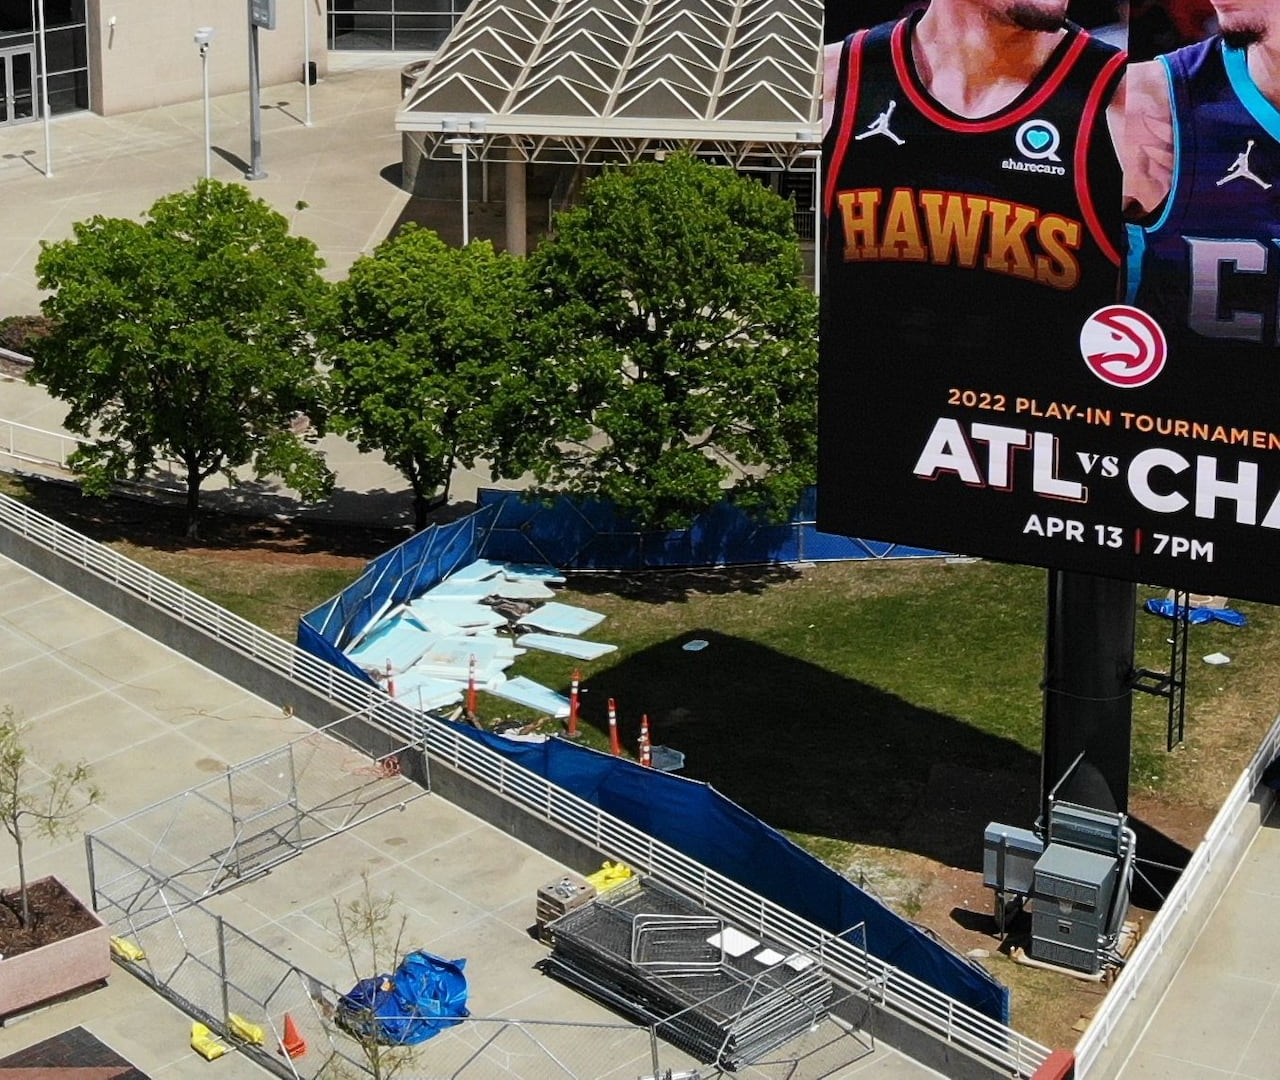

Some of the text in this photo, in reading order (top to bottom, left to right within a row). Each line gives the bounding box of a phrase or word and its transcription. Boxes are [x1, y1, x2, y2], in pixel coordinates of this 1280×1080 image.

[1001, 158, 1066, 176] sharecare
[836, 187, 1081, 291] HAWKS
[947, 388, 1007, 413] 2022
[1015, 397, 1112, 426] PLAY-IN
[912, 417, 1088, 503] ATL
[1023, 513, 1214, 564] APR 13 7PM
